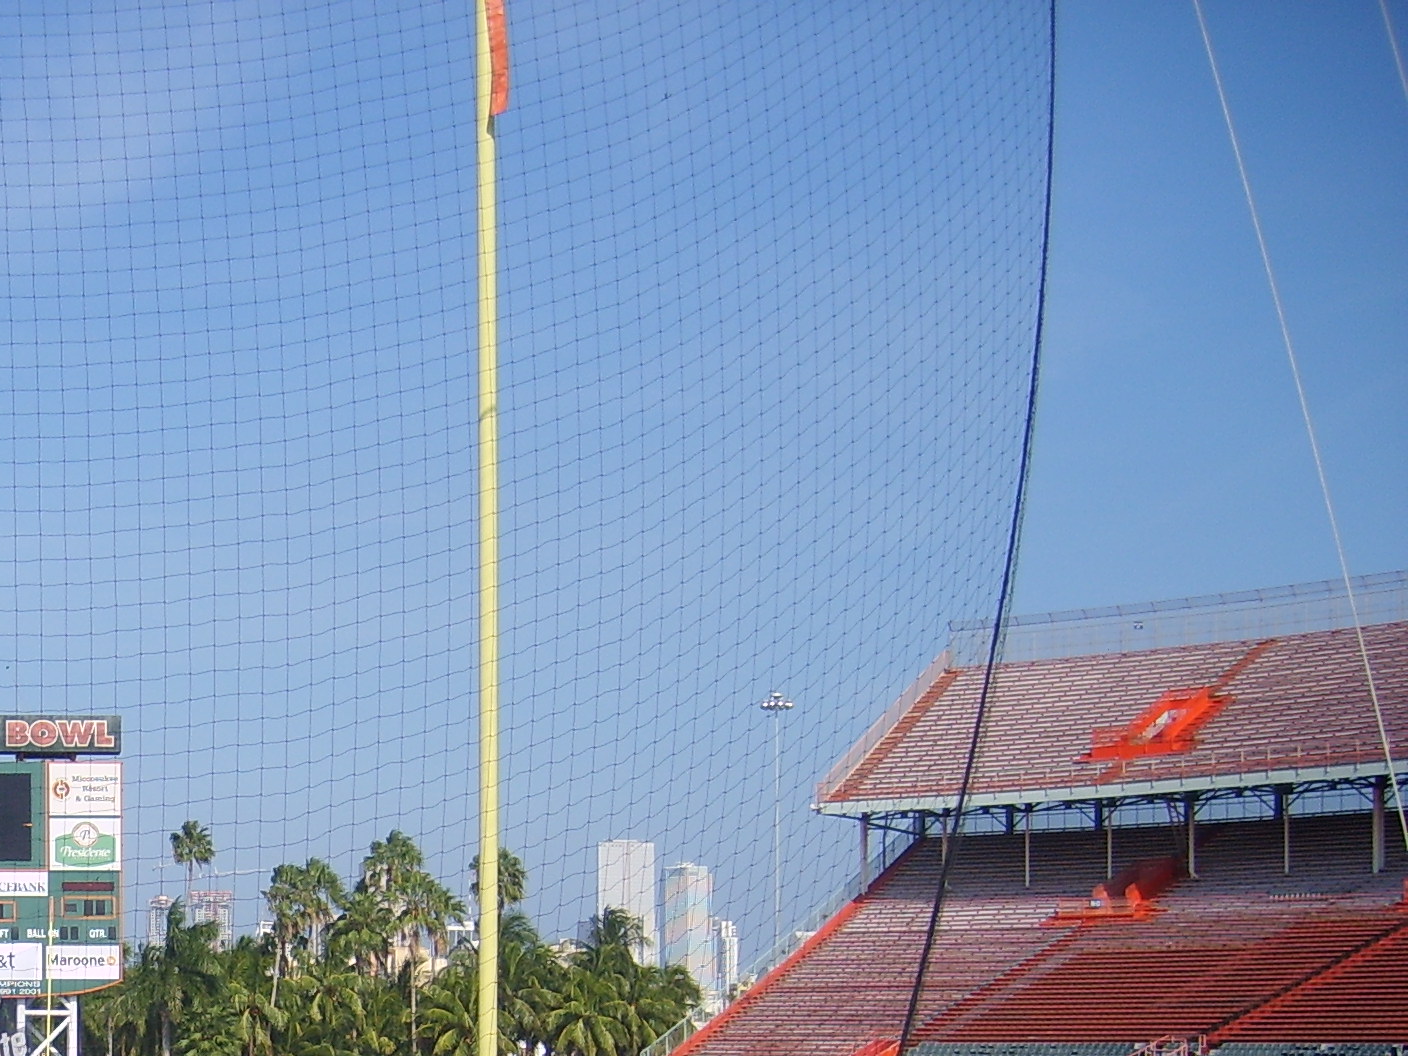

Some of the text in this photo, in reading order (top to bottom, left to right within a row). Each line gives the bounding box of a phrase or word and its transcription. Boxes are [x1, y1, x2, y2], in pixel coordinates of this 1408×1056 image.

[6, 720, 115, 747] BOWL
[26, 929, 47, 939] BALL
[48, 954, 106, 967] Maroone
